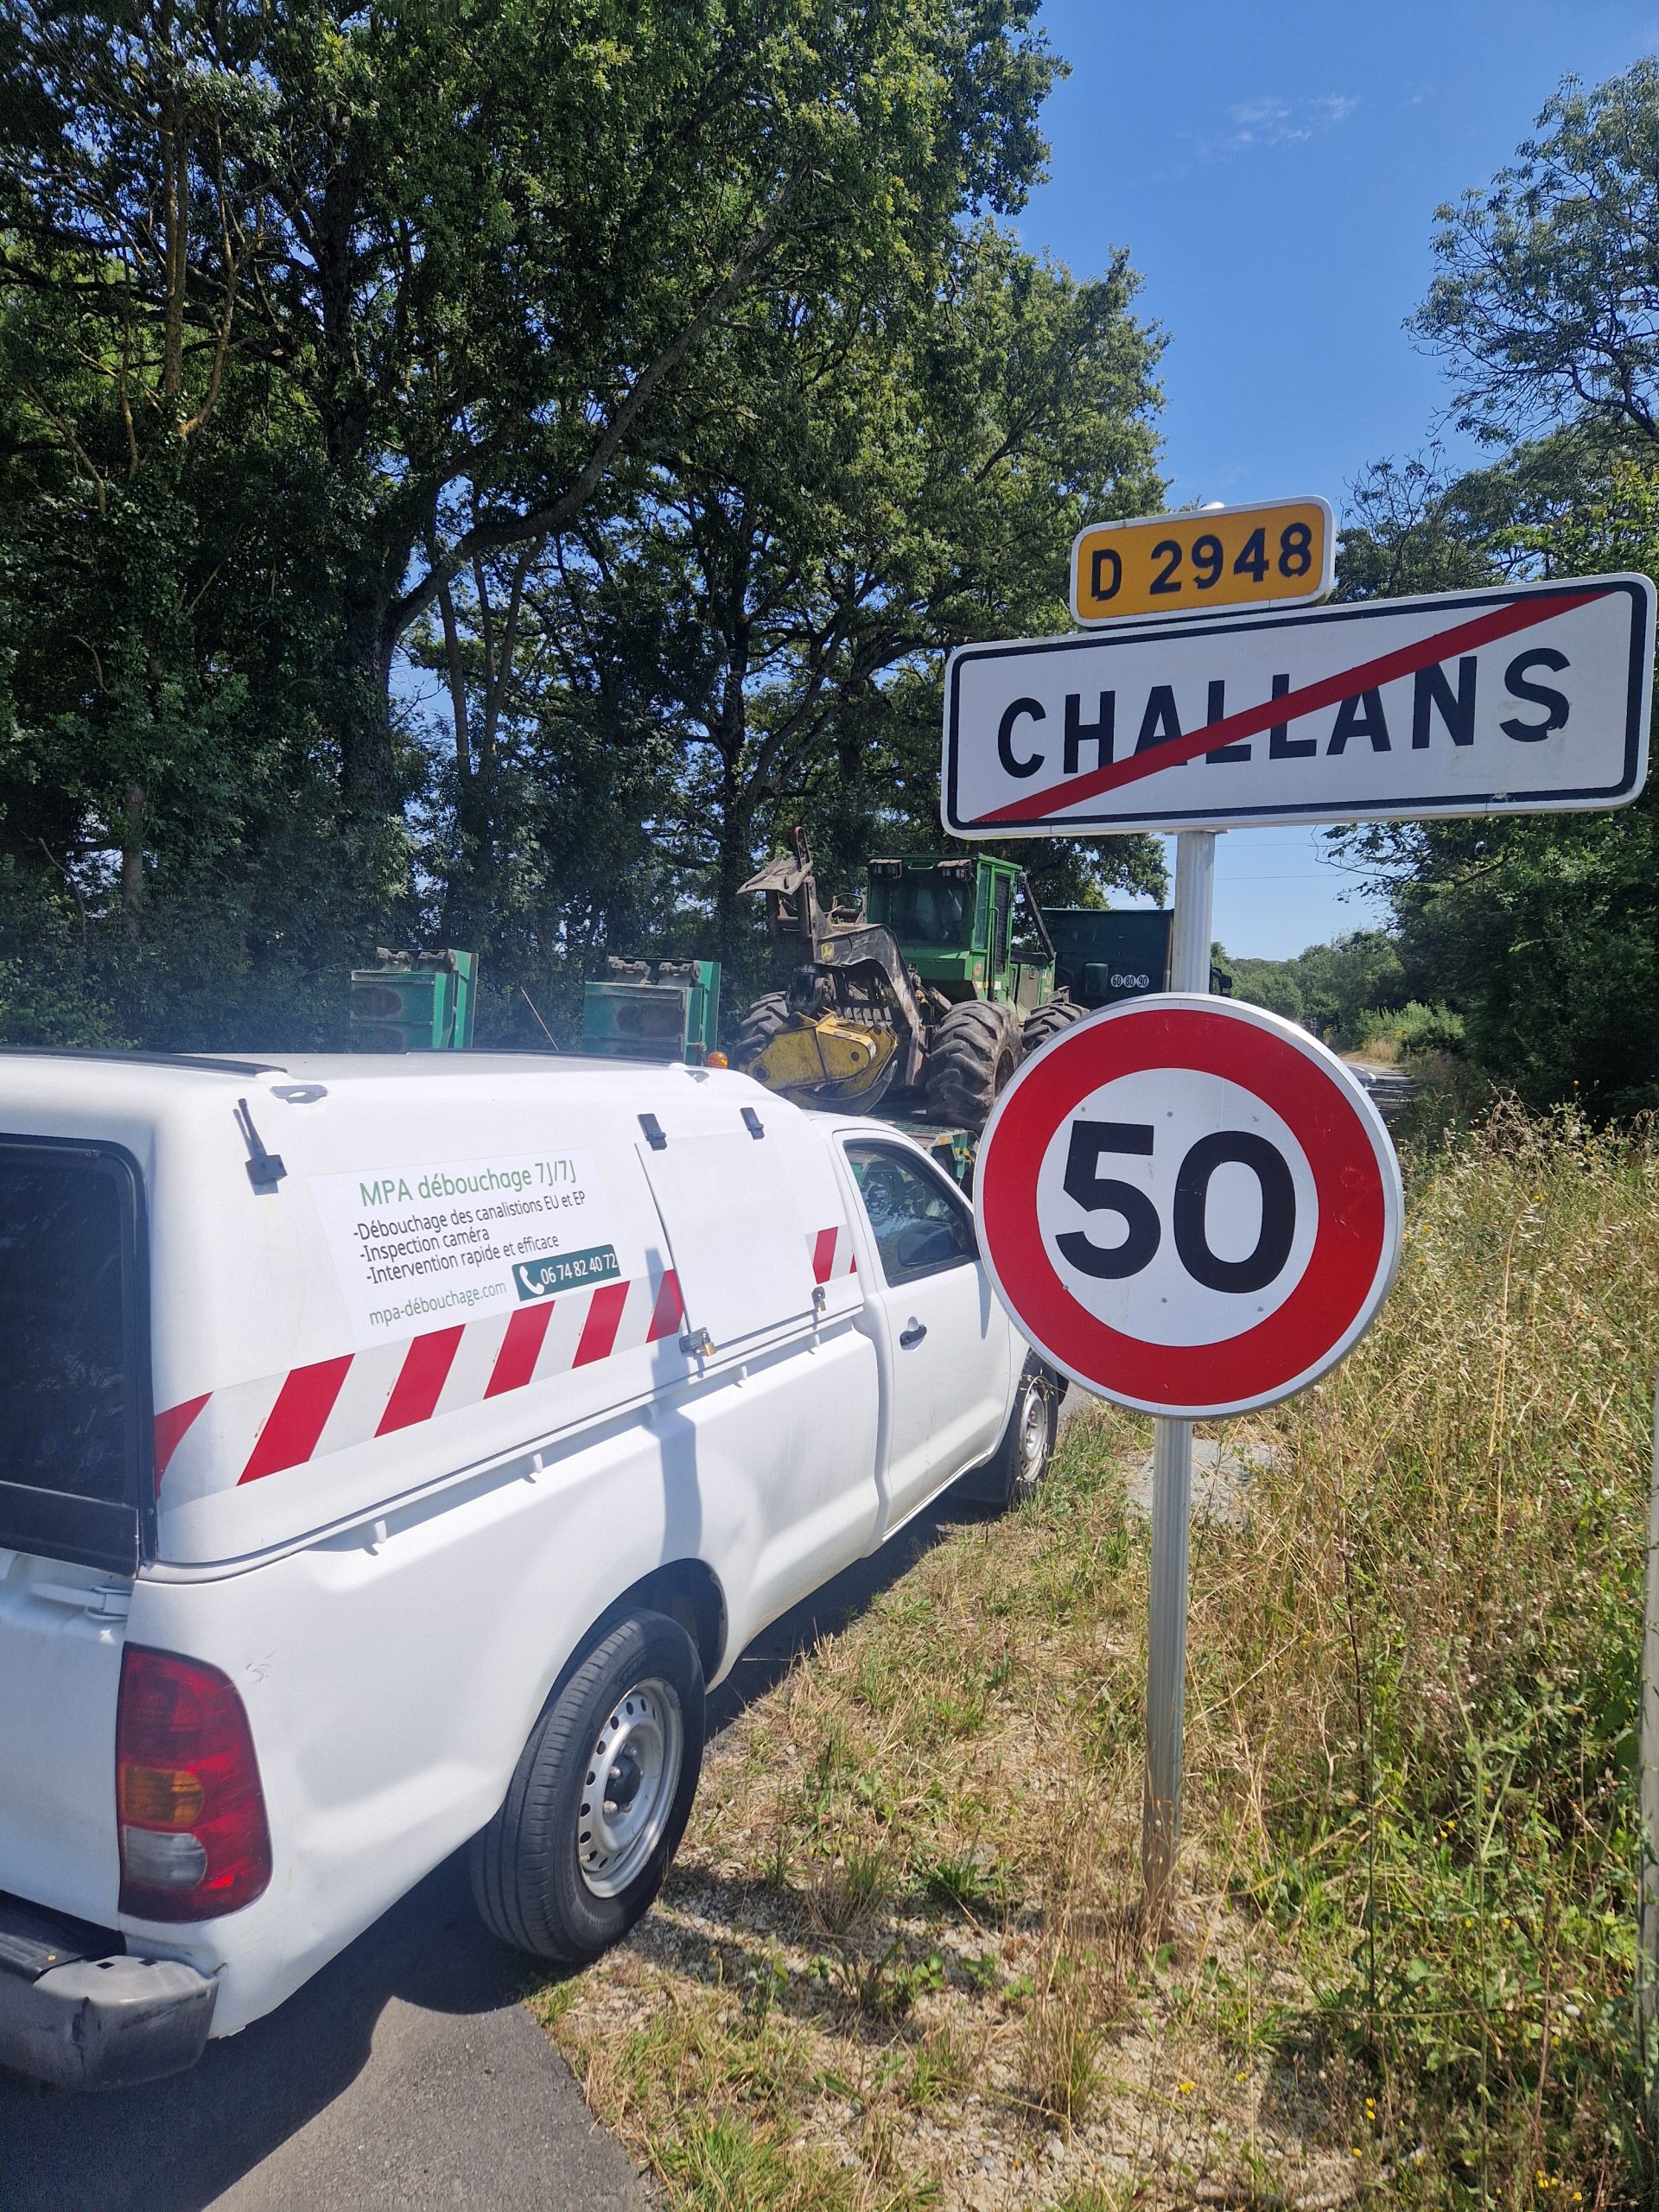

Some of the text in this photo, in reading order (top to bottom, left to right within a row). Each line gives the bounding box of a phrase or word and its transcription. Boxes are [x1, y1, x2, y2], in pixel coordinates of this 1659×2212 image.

[1090, 522, 1312, 601] D 2948
[997, 647, 1571, 779] CHALLANS
[1112, 976, 1122, 986] 60
[1125, 976, 1135, 986] 80
[1138, 976, 1147, 986] 90
[359, 1178, 413, 1207] MPA
[418, 1168, 532, 1199] débouchage
[1055, 1120, 1297, 1294] 50
[353, 1191, 586, 1241] -Débouchage des canalistions EU et EP
[359, 1226, 490, 1263] -Inspection caméra
[366, 1235, 560, 1284] -Intervention rapide et efficace
[540, 1253, 618, 1285] 06 74 82 40 72
[369, 1282, 507, 1327] mpa-débouchage.com
